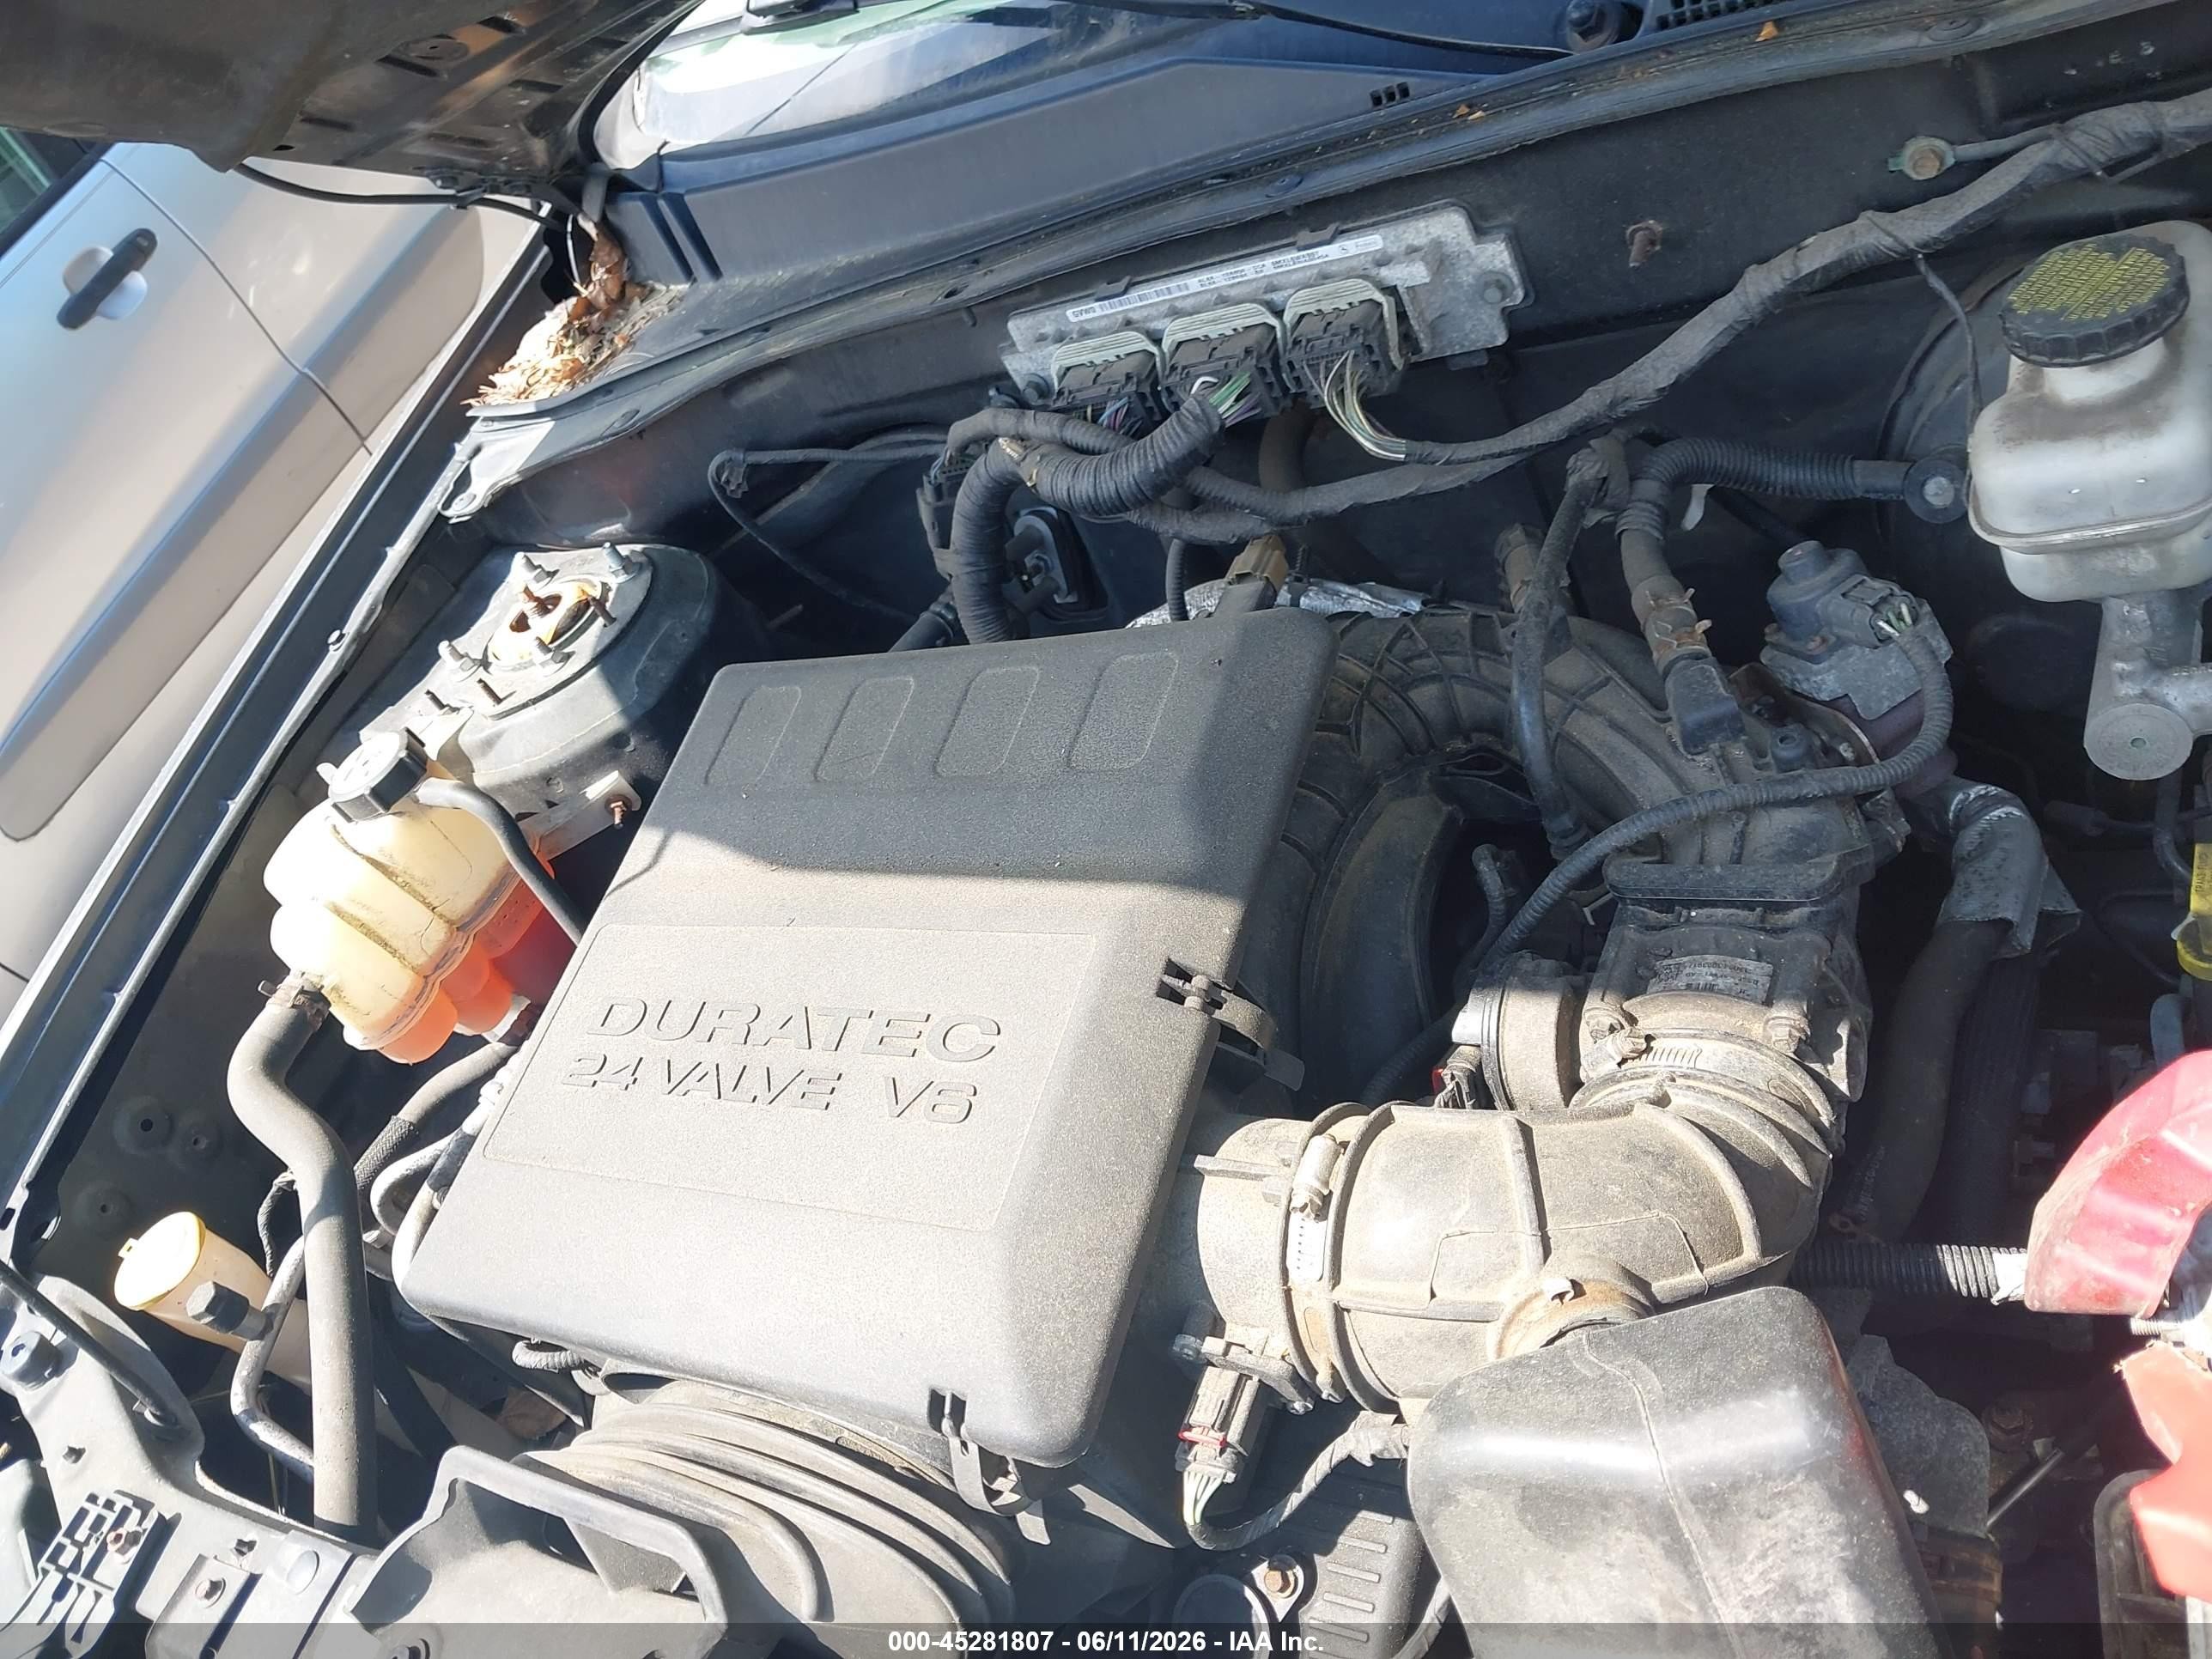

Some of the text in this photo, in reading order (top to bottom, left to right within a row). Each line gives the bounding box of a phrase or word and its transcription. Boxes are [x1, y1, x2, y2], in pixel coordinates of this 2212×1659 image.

[586, 997, 1001, 1063] DURATEC
[561, 1052, 978, 1124] 24 VALVE V6
